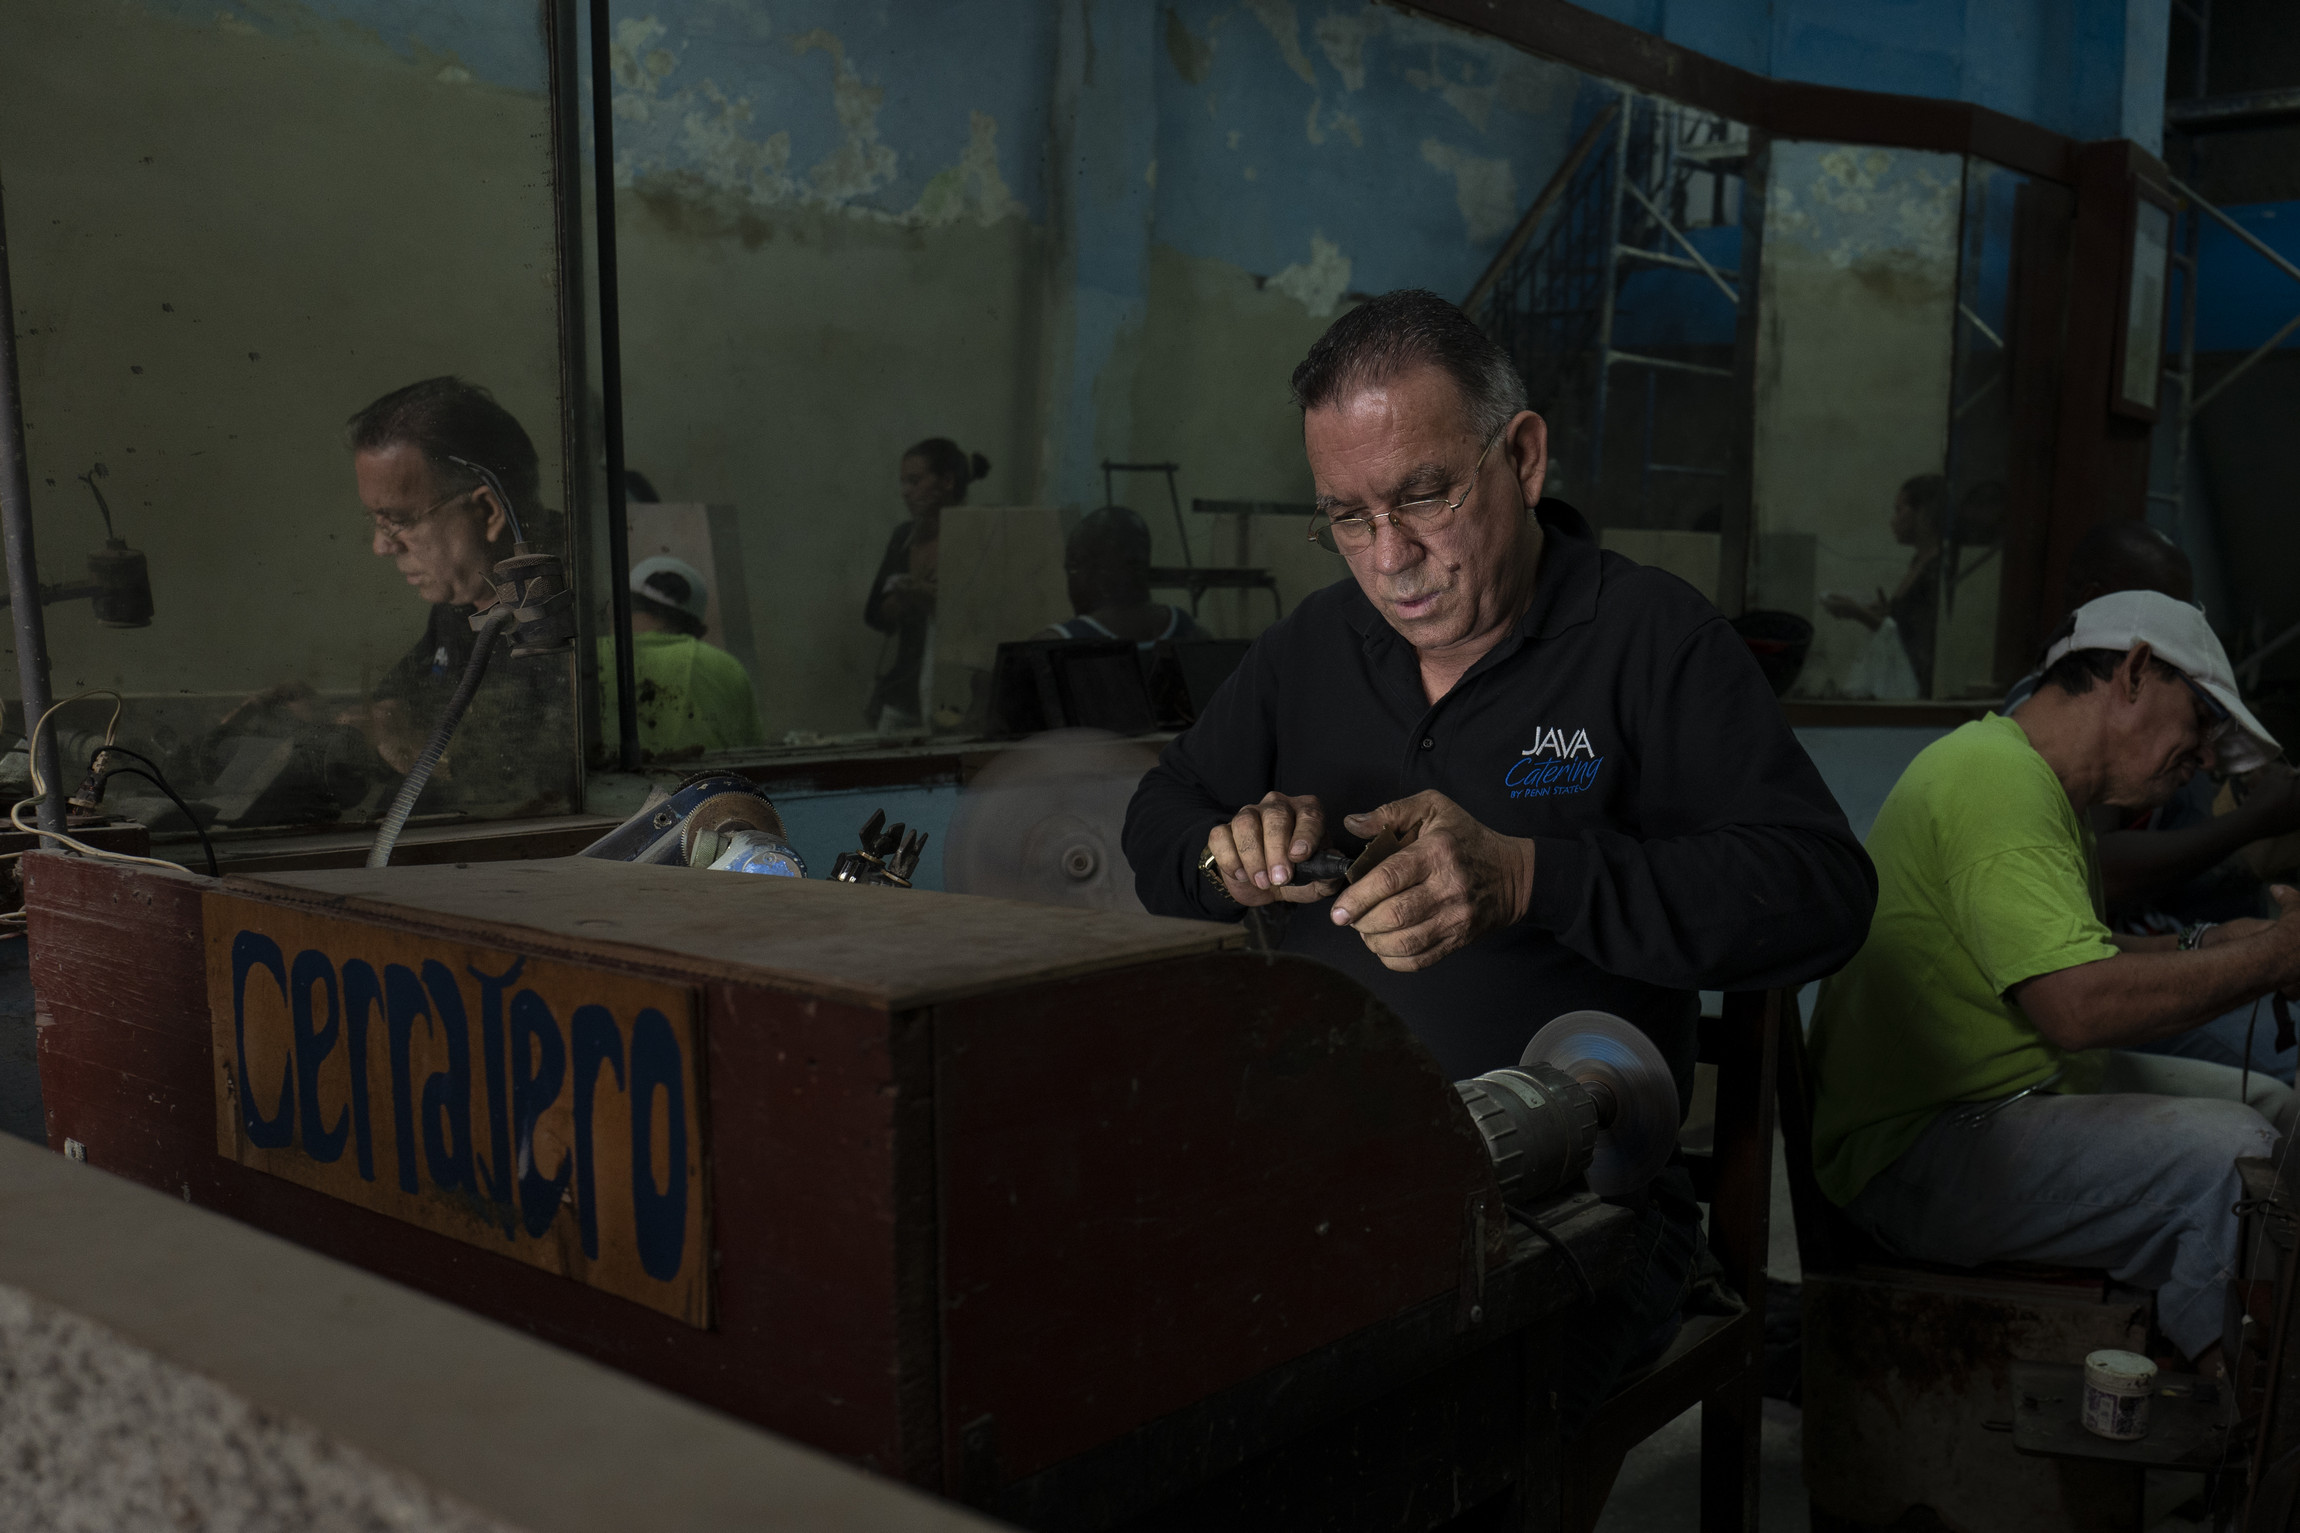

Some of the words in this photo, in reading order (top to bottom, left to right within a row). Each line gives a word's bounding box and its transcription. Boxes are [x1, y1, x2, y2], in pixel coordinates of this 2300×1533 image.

[1521, 726, 1595, 759] JAVA
[1505, 756, 1604, 791] Catering
[1510, 790, 1523, 798] BY
[1524, 786, 1551, 798] PENN
[1553, 784, 1580, 795] STATE
